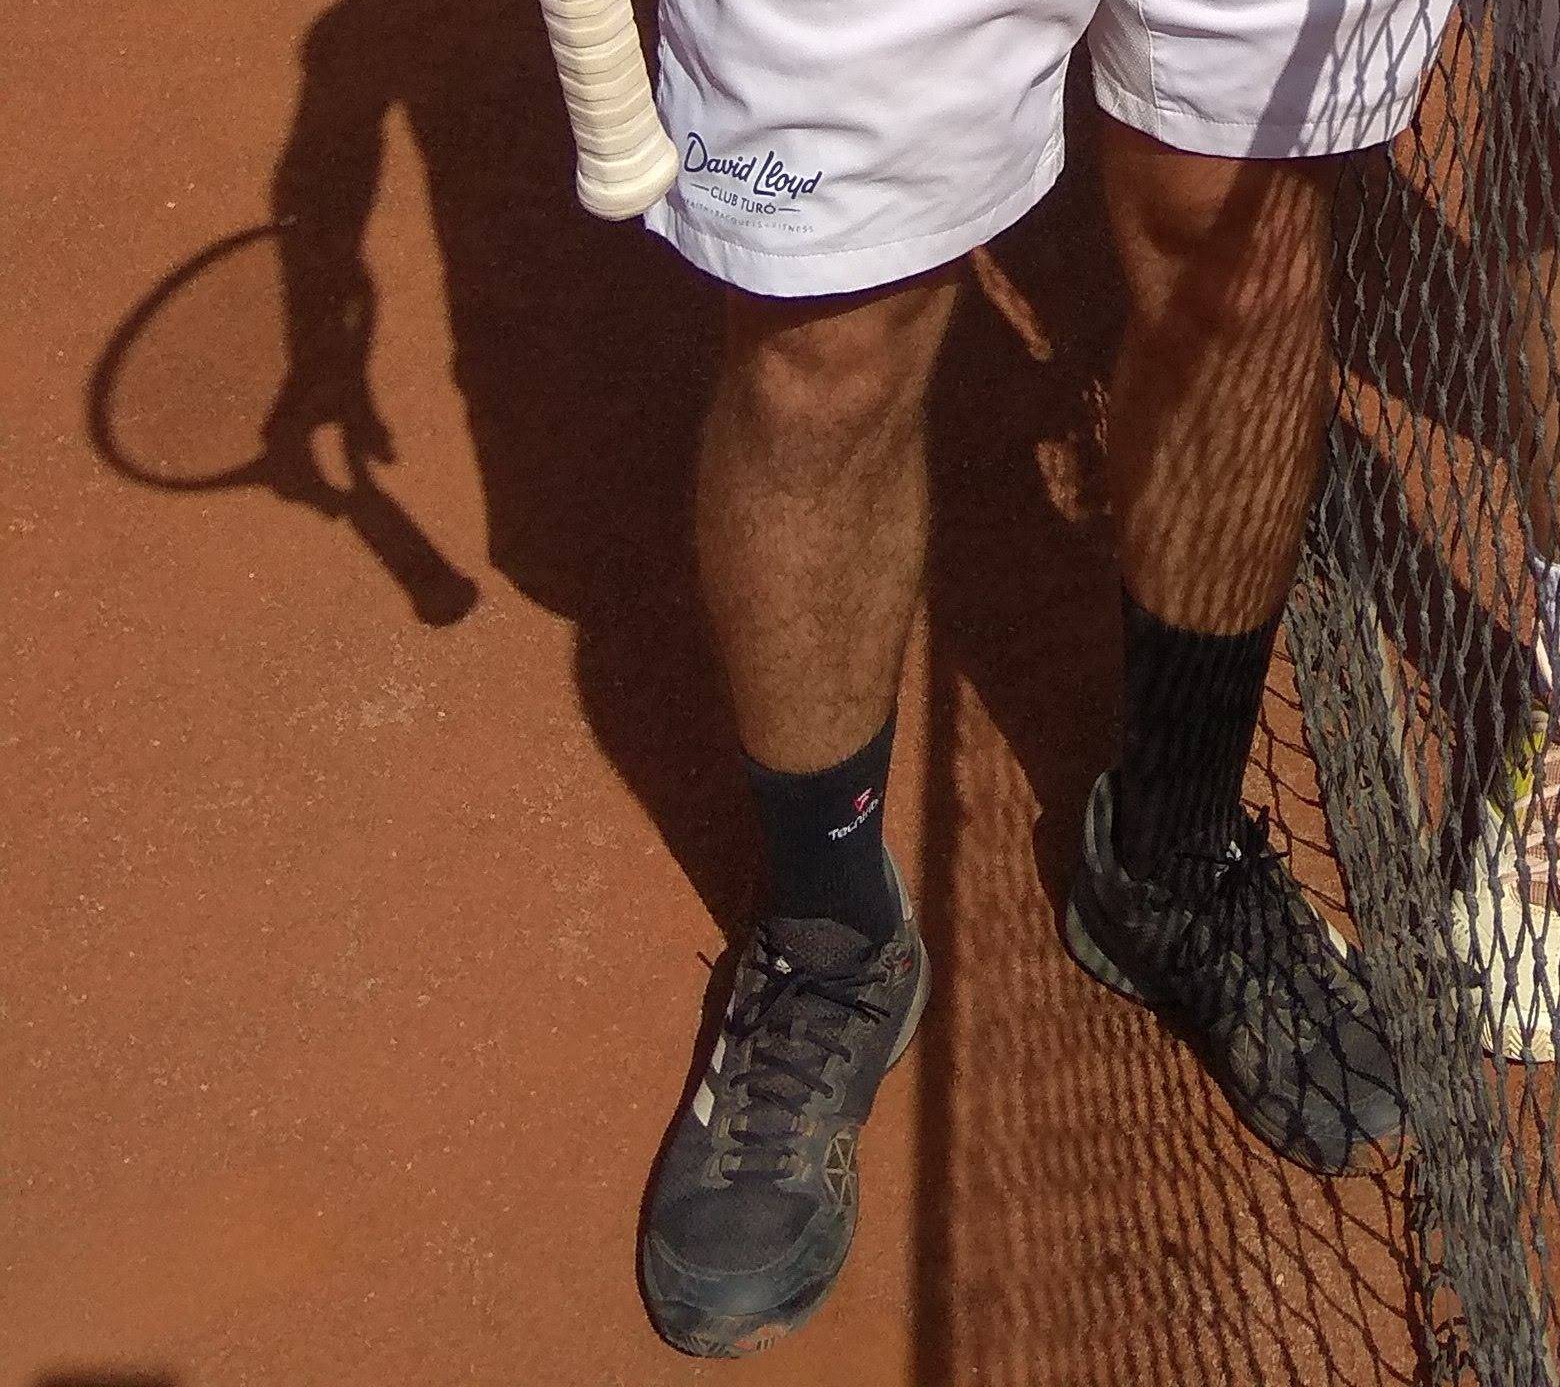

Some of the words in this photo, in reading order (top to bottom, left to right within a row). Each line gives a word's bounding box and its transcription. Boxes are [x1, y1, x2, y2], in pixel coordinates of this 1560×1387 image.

[683, 131, 757, 182] David
[753, 150, 822, 199] Lloyd
[710, 185, 739, 207] CLUB
